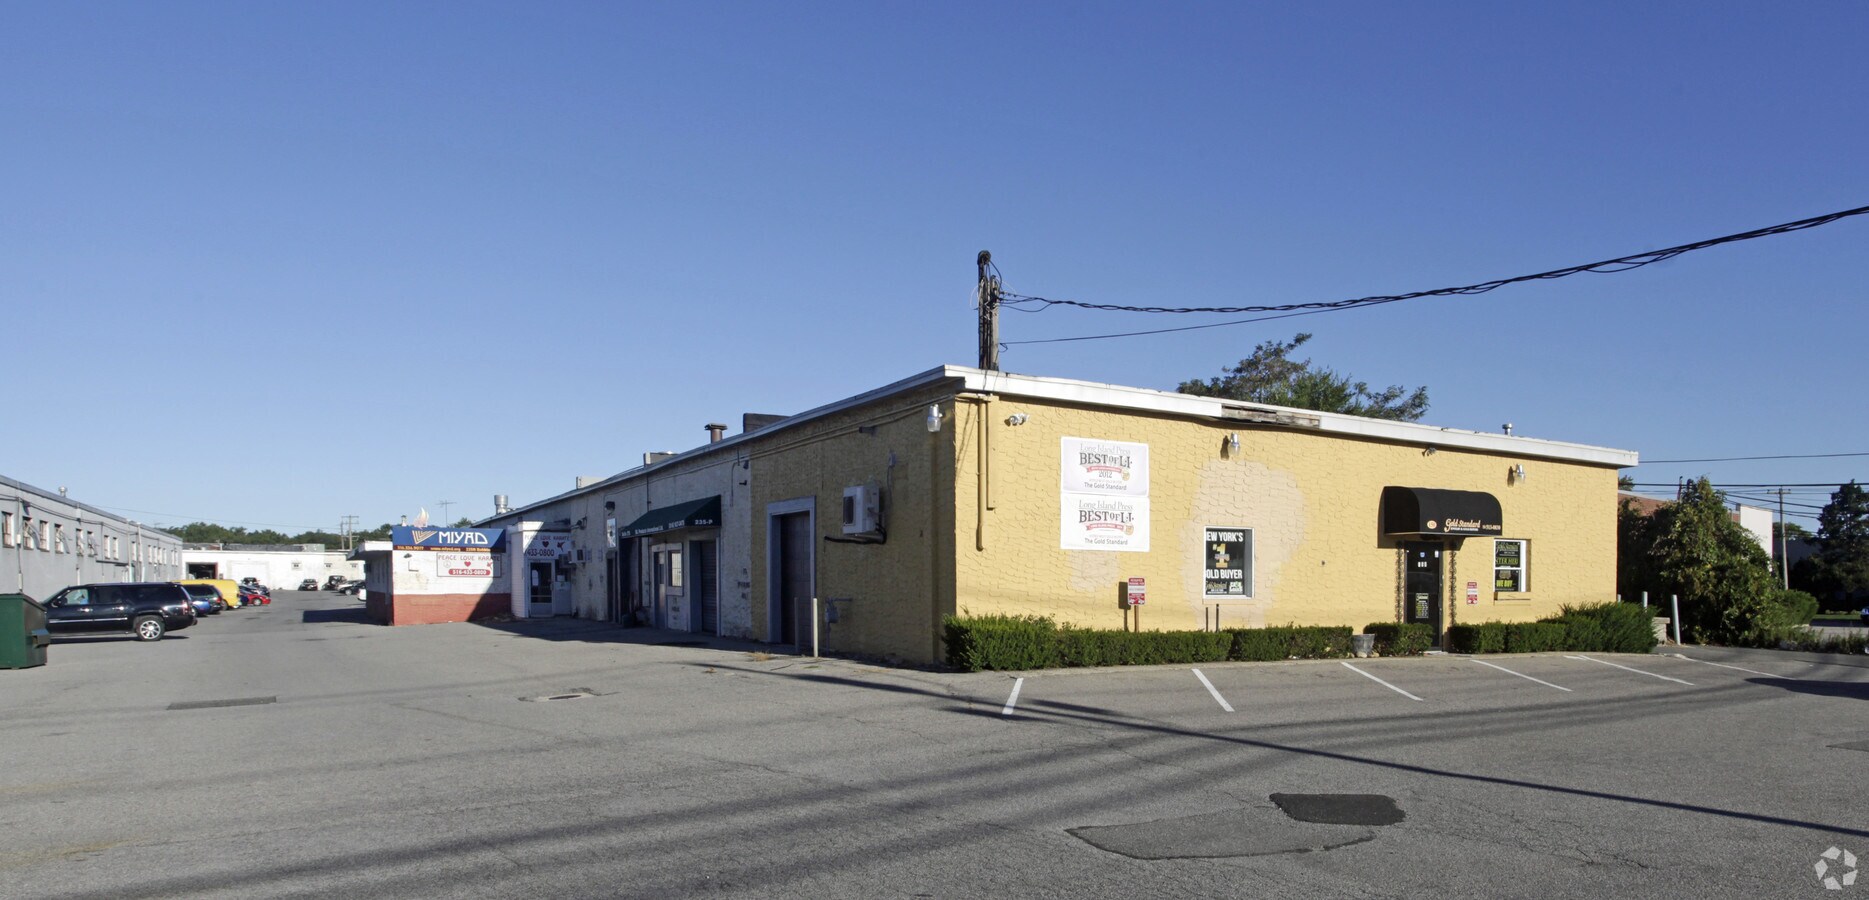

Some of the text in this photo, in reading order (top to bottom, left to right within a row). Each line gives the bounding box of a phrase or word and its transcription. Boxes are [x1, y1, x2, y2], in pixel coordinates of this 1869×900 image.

[1080, 443, 1131, 455] Long Island Press
[1079, 452, 1108, 465] BEST
[1079, 500, 1133, 510] Long Island Press
[1079, 510, 1109, 523] BEST
[1444, 518, 1459, 532] Gold
[1458, 520, 1481, 528] Standard
[439, 531, 488, 544] MIYAD
[1206, 531, 1244, 542] EW YORK'S
[1206, 569, 1243, 579] OLD BUYER
